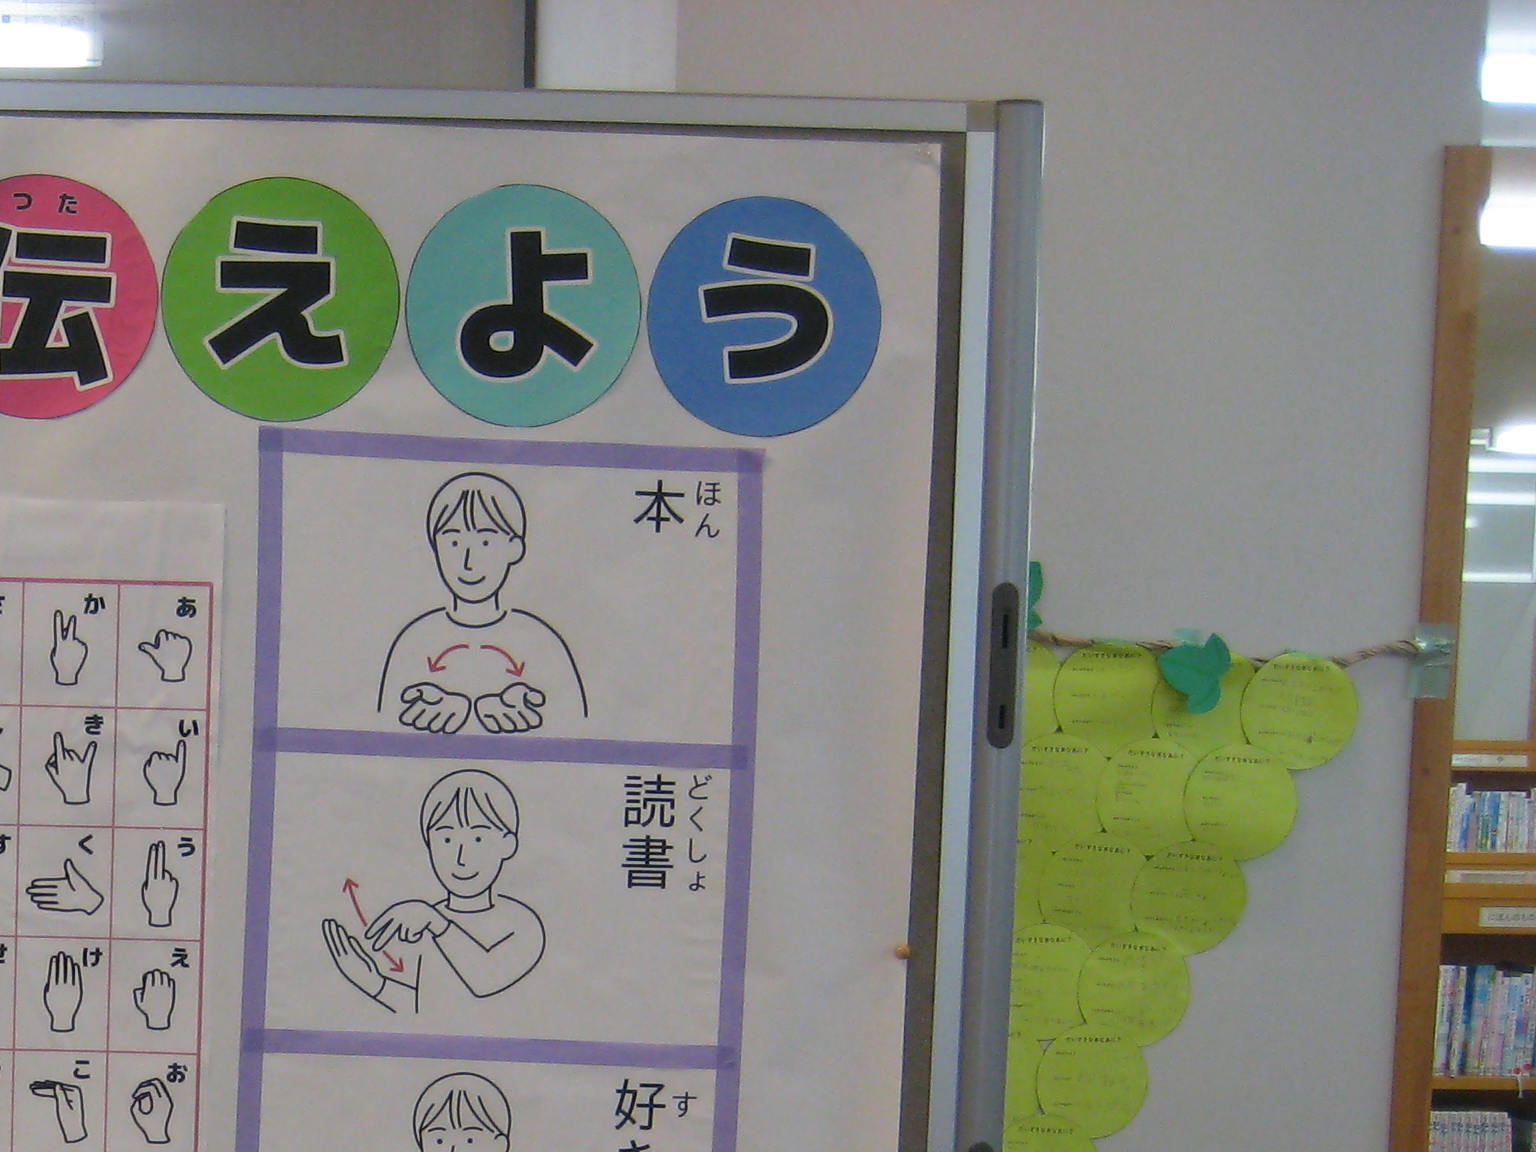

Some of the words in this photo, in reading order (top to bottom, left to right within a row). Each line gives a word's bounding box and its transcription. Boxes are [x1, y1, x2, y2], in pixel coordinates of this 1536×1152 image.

[634, 479, 685, 533] 本
[695, 480, 721, 539] ほん
[84, 594, 105, 614] か
[177, 598, 196, 617] あ
[85, 715, 104, 735] き
[179, 719, 198, 736] い
[621, 773, 676, 890] 読書
[688, 774, 713, 892] どくしょ
[79, 835, 93, 854] く
[178, 838, 195, 856] う
[82, 949, 103, 967] け
[171, 948, 189, 968] え
[74, 1061, 91, 1079] こ
[167, 1063, 188, 1082] お
[672, 1091, 698, 1118] す
